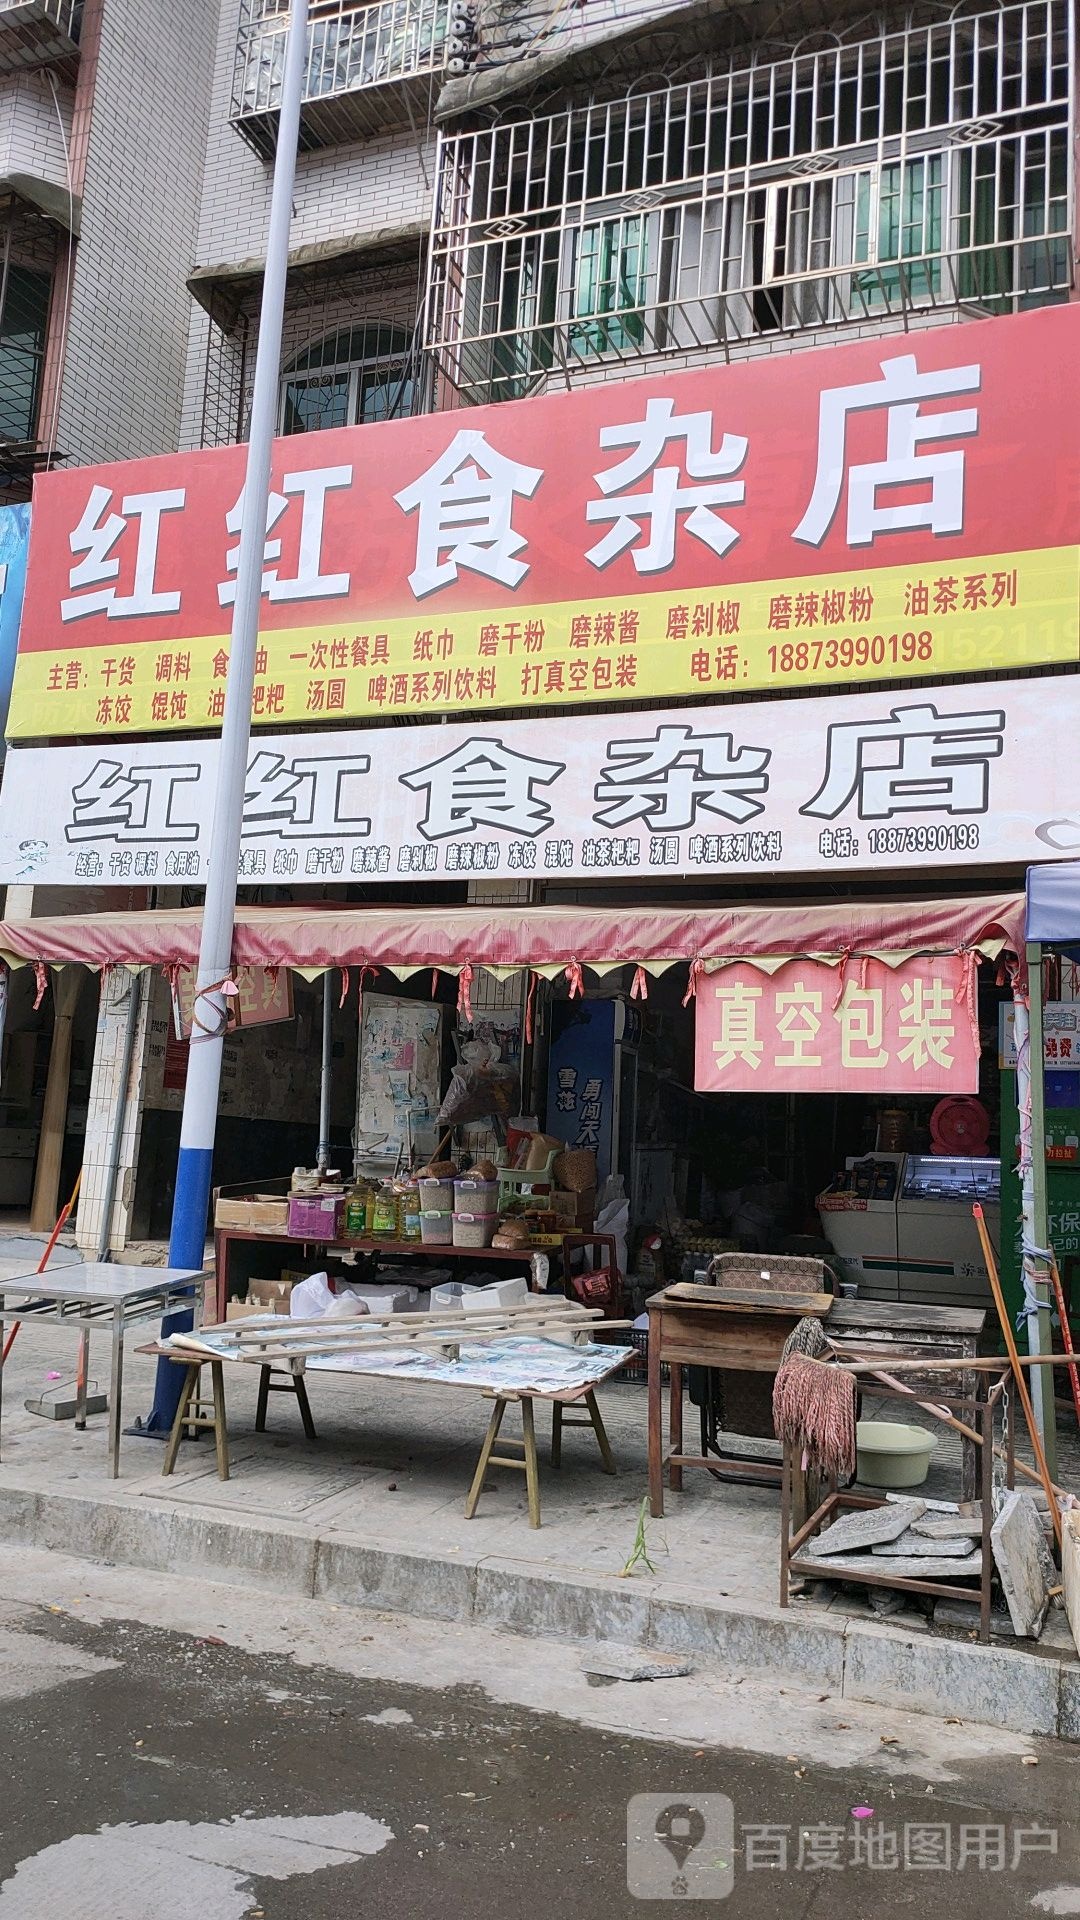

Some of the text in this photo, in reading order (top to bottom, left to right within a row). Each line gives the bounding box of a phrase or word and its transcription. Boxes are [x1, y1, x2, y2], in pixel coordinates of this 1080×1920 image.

[60, 354, 982, 622] 红红食杂店
[47, 569, 1018, 691] 主营： 干货 调料 食油 一次性餐具 纸巾 磨干粉 磨辣酱 磨剁椒 磨辣椒粉 油茶系列
[95, 630, 933, 725] 冻饺 馄饨 油粑粑 汤圆 啤酒系列饮料 打真空包装 电话： 18873990198
[64, 703, 1005, 843] 红红食杂店
[109, 851, 132, 877] 干货
[135, 850, 159, 876] 调料
[165, 849, 200, 876] 食用油
[273, 848, 299, 875] 纸巾
[305, 847, 344, 874] 磨干粉
[350, 845, 390, 873] 磨辣酱
[444, 842, 500, 871] 磨辣椒粉
[508, 841, 536, 869] 冻饺
[581, 837, 640, 867] 油茶粑粑
[649, 836, 679, 865] 汤圆
[688, 831, 782, 864] 啤酒系列饮料
[819, 827, 859, 858] 电话：
[868, 824, 980, 853] 18873990198
[712, 978, 955, 1072] 真空包装
[1046, 1038, 1080, 1058] 免费
[558, 1067, 578, 1112] 雪花
[573, 1078, 603, 1158] 勇闯天
